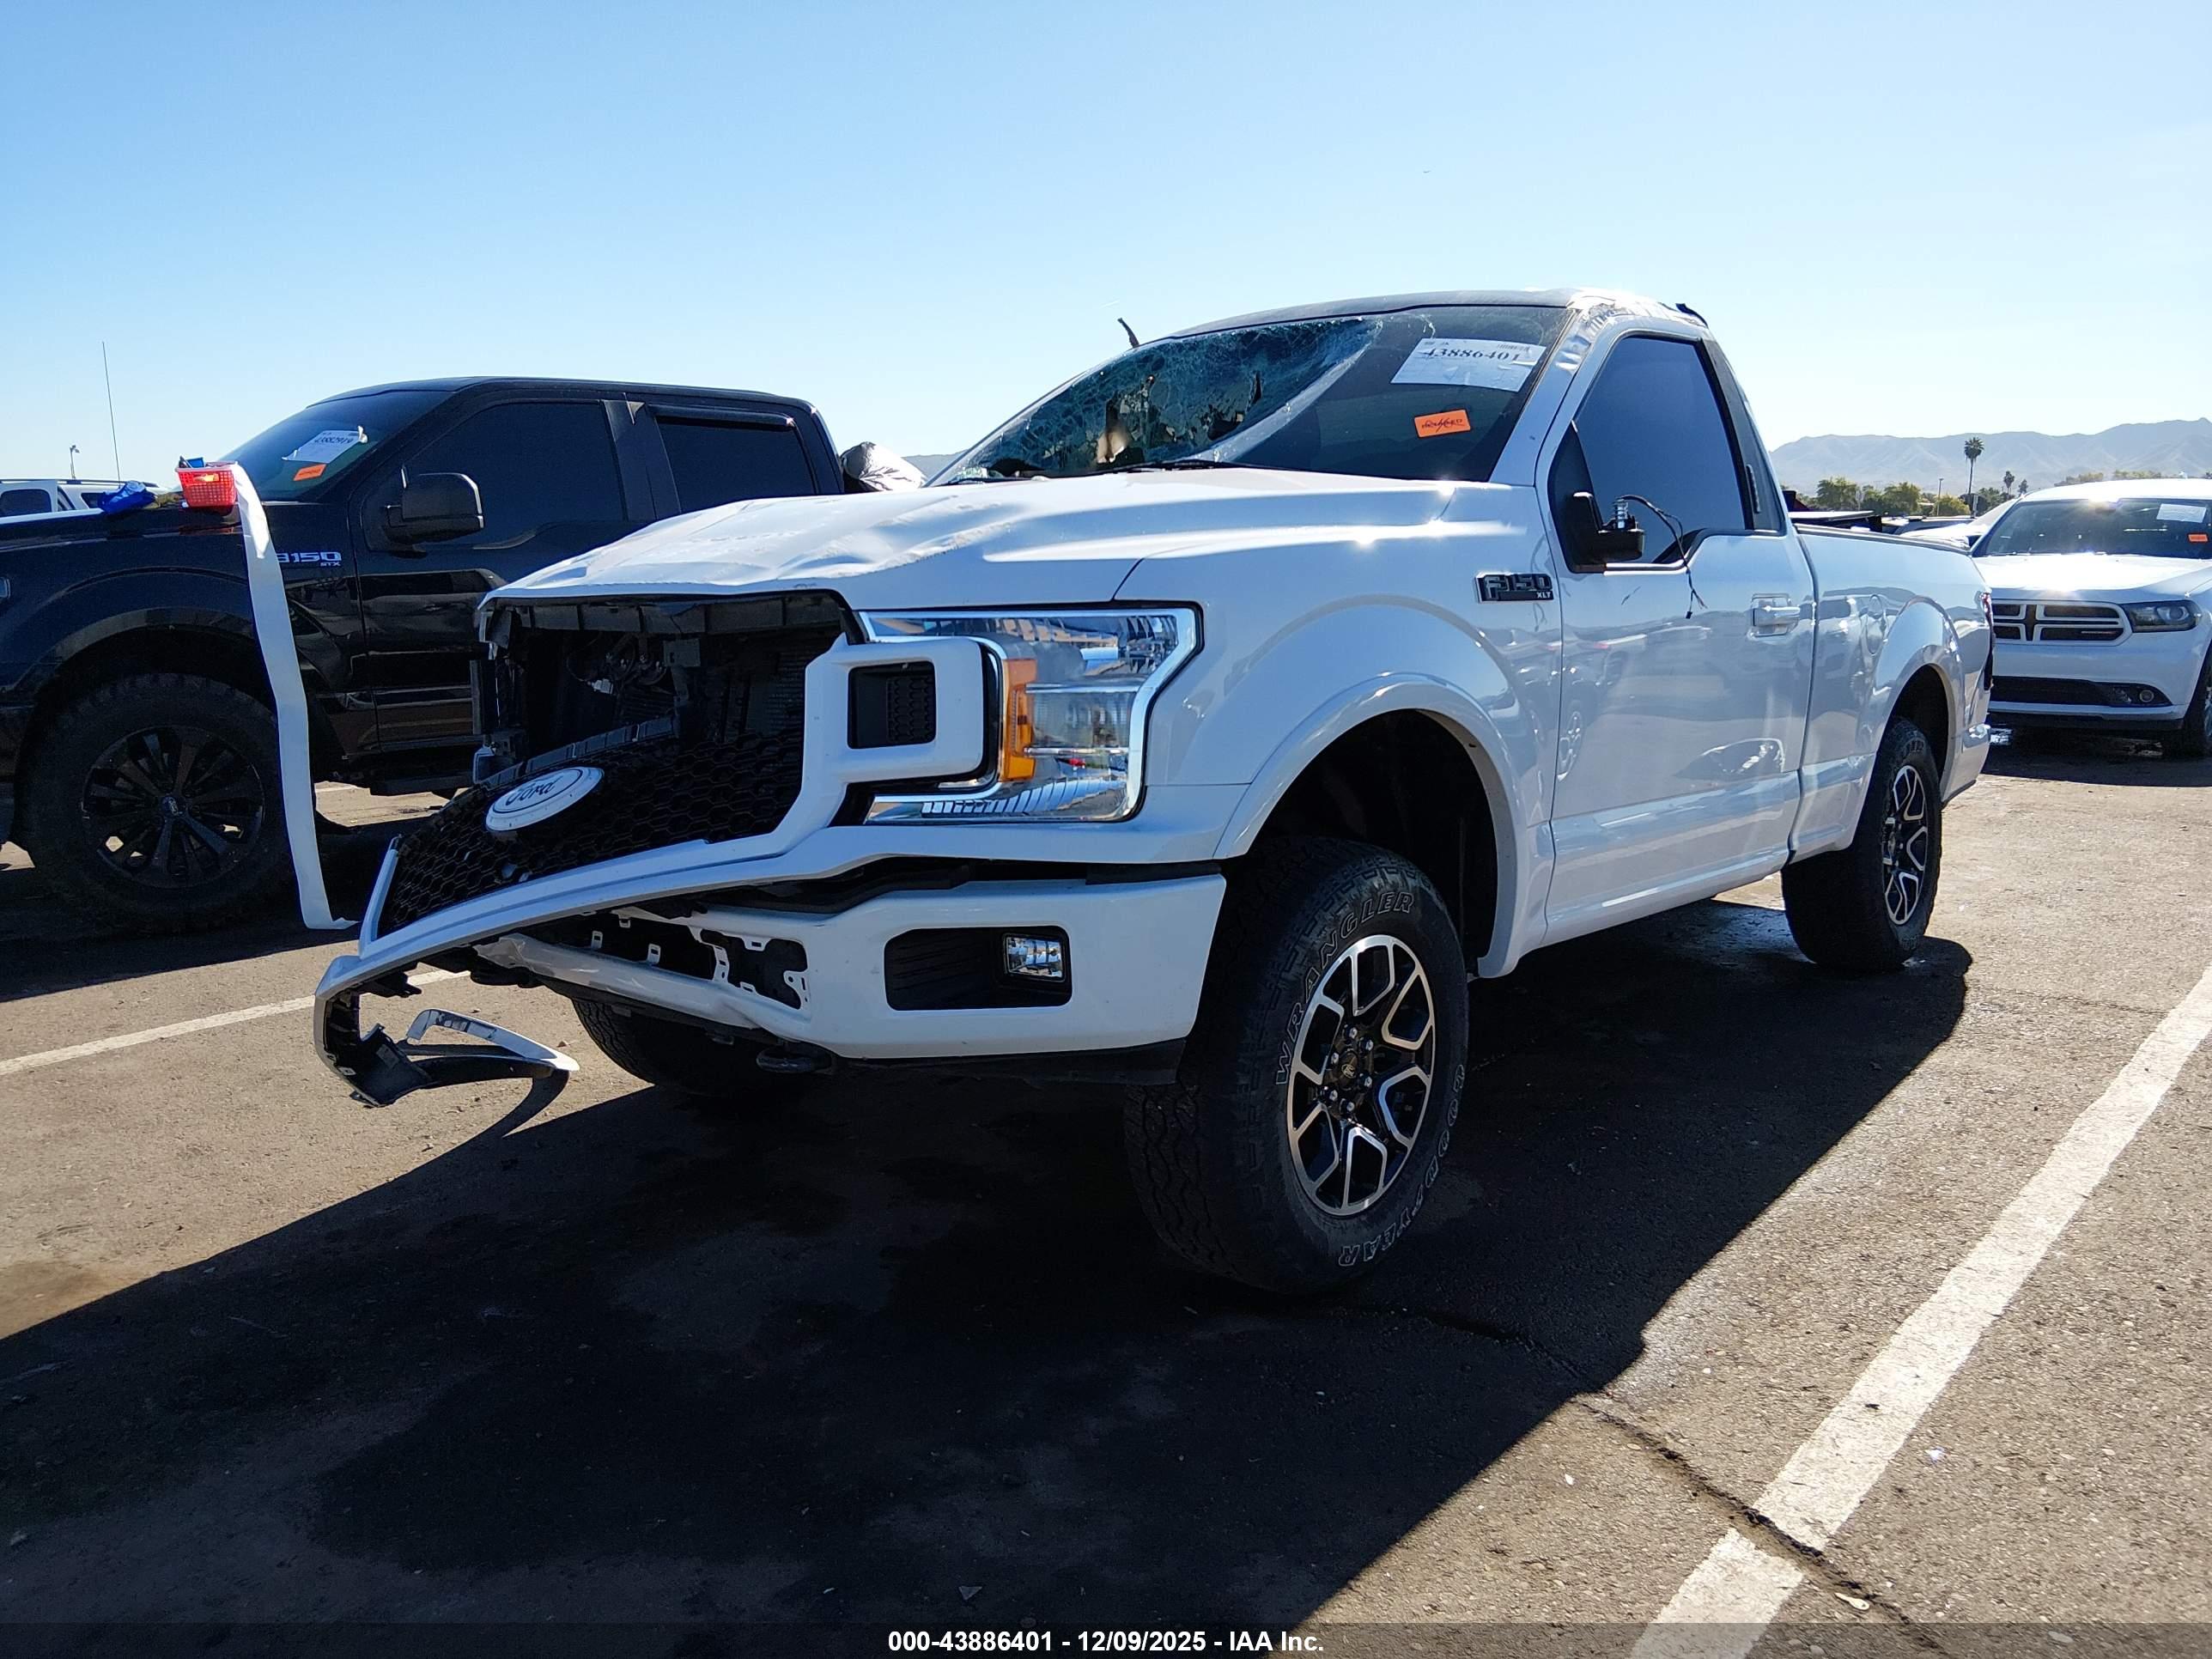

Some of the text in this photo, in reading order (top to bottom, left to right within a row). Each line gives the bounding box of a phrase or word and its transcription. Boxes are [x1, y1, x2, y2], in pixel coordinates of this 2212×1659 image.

[1423, 346, 1521, 362] 43886401
[505, 775, 564, 806] Ford
[1275, 891, 1414, 1085] WRANGLER
[1338, 1064, 1466, 1267] GOODYEAR
